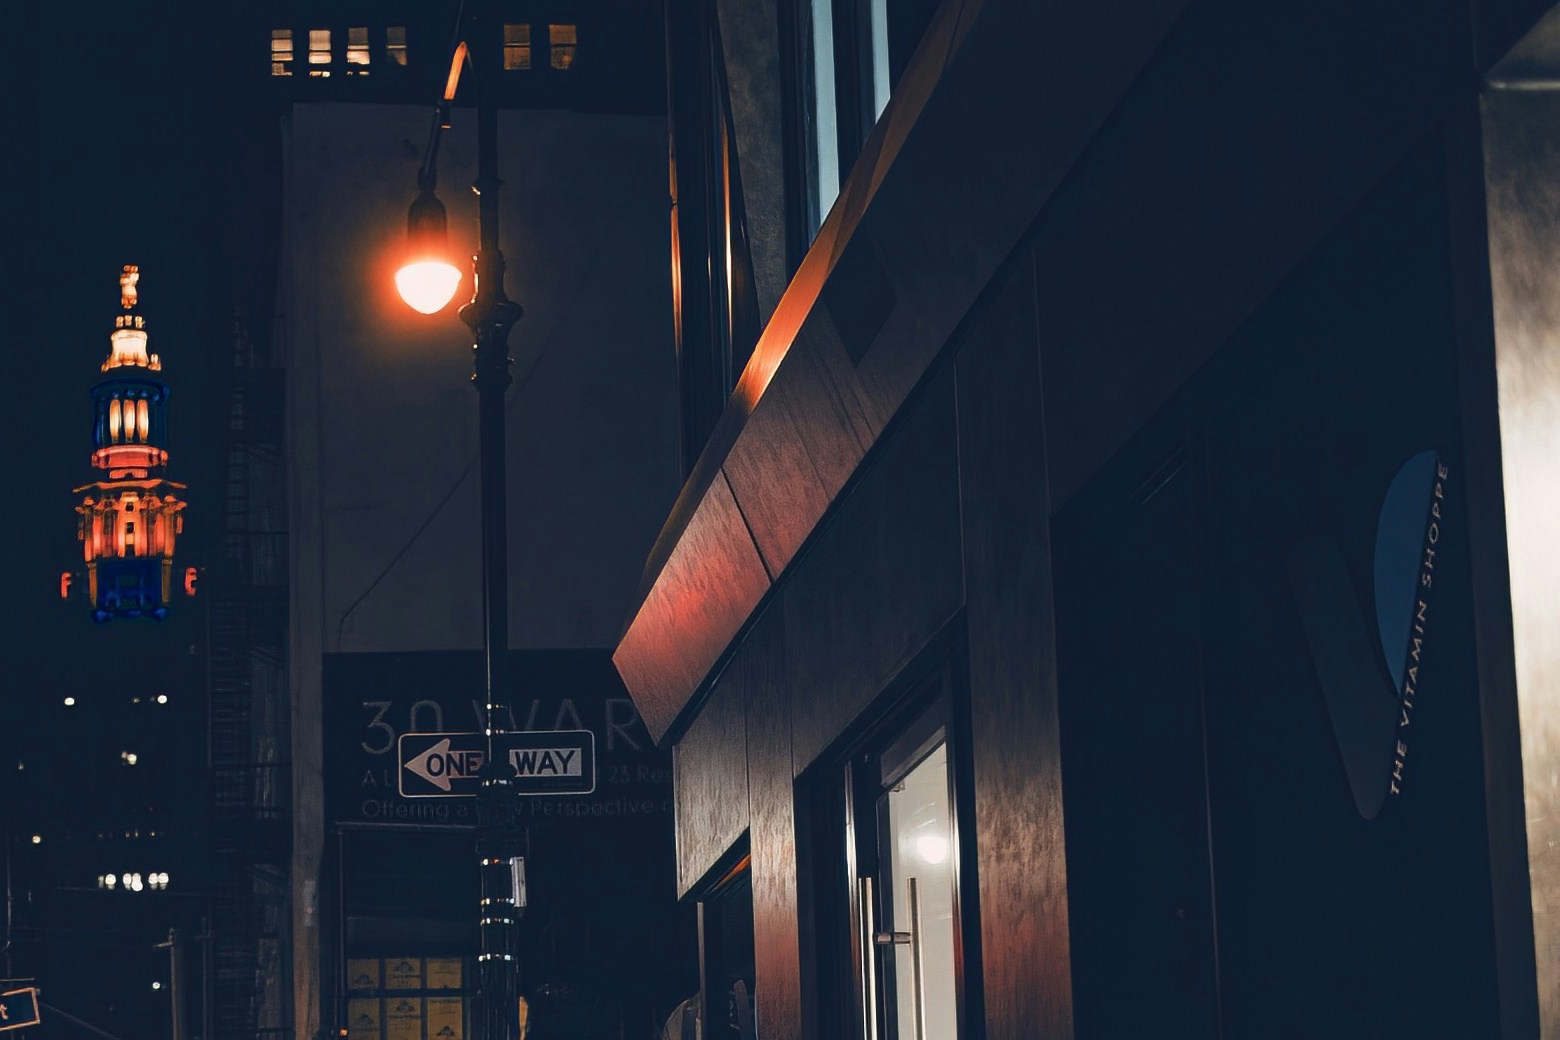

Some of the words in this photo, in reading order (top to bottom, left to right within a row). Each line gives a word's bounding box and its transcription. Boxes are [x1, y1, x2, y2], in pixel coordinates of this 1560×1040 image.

[1390, 739, 1408, 796] THE
[1399, 600, 1429, 728] VITAMIN
[1421, 462, 1450, 587] SHOPPE
[427, 751, 481, 777] ONE
[514, 749, 575, 775] WAY
